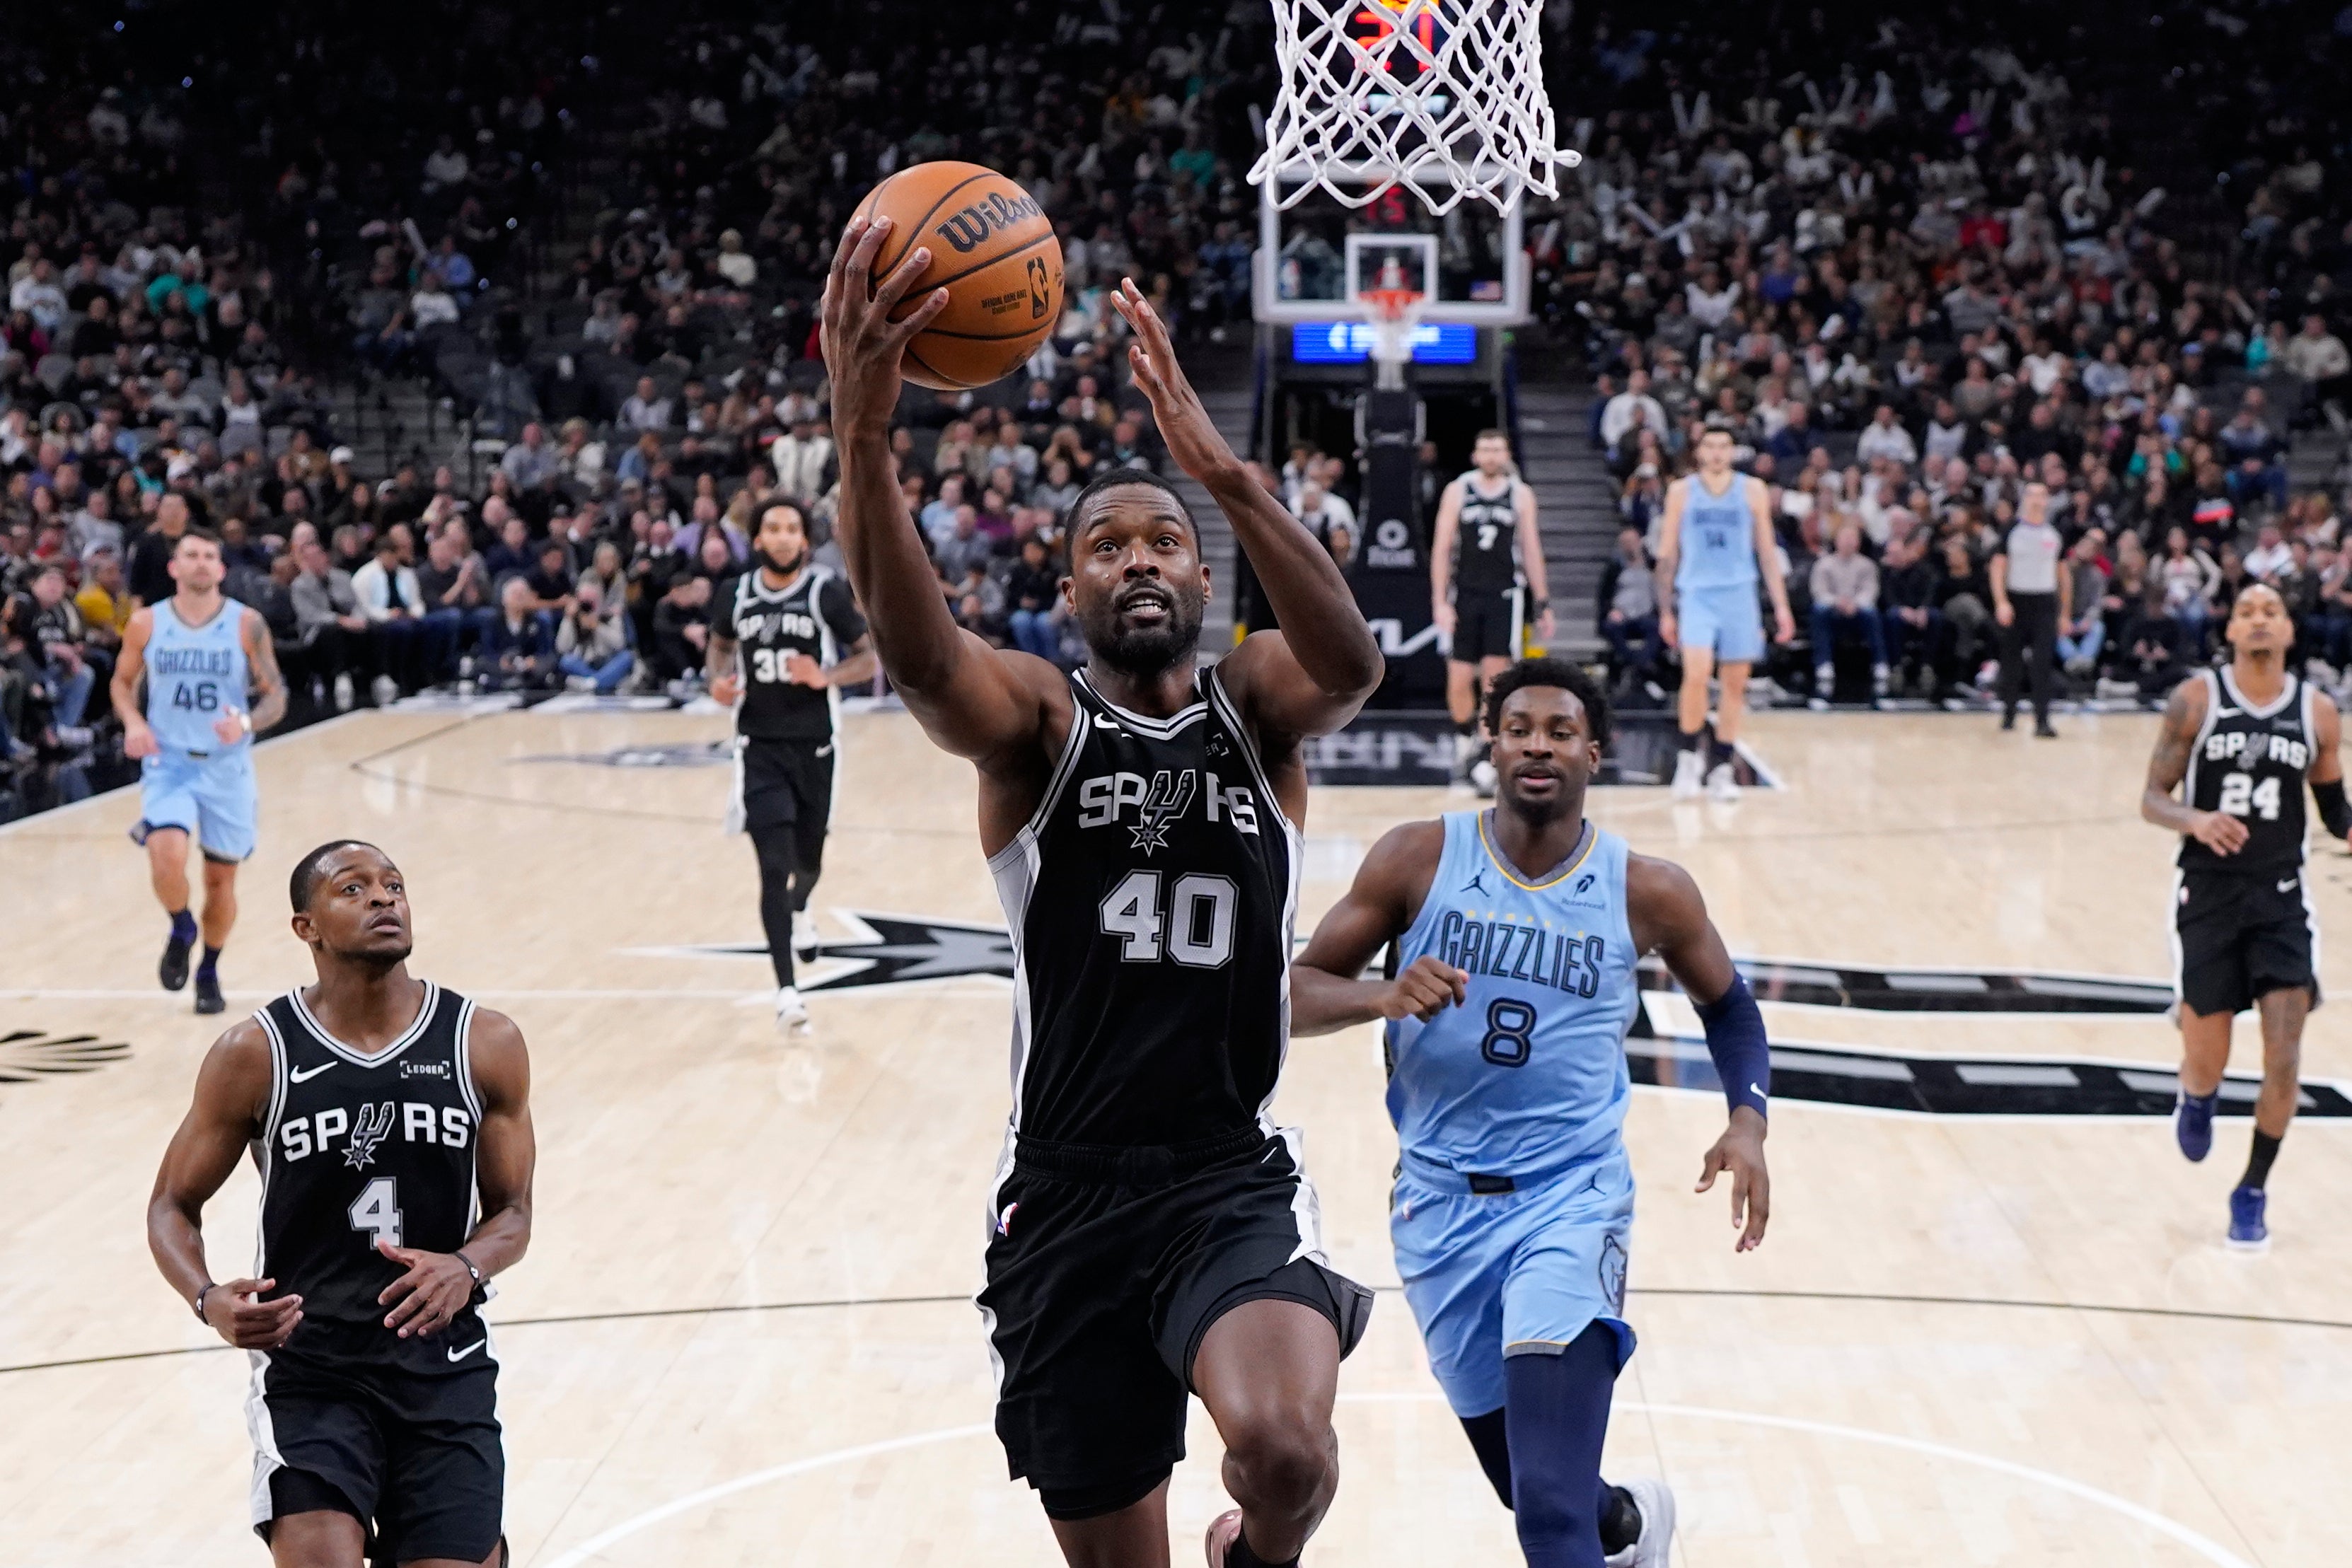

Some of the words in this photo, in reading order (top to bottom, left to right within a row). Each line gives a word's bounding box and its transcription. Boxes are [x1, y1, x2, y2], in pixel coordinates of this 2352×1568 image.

[172, 680, 218, 712] 46
[2205, 731, 2307, 770] SPURS
[2219, 772, 2281, 820] 24
[1099, 869, 1239, 970] 40
[1439, 910, 1604, 999] GRIZZLIES
[1481, 997, 1538, 1069] 8
[406, 1064, 444, 1075] LEDGER
[281, 1100, 470, 1171] SPURS
[347, 1175, 404, 1251] 4
